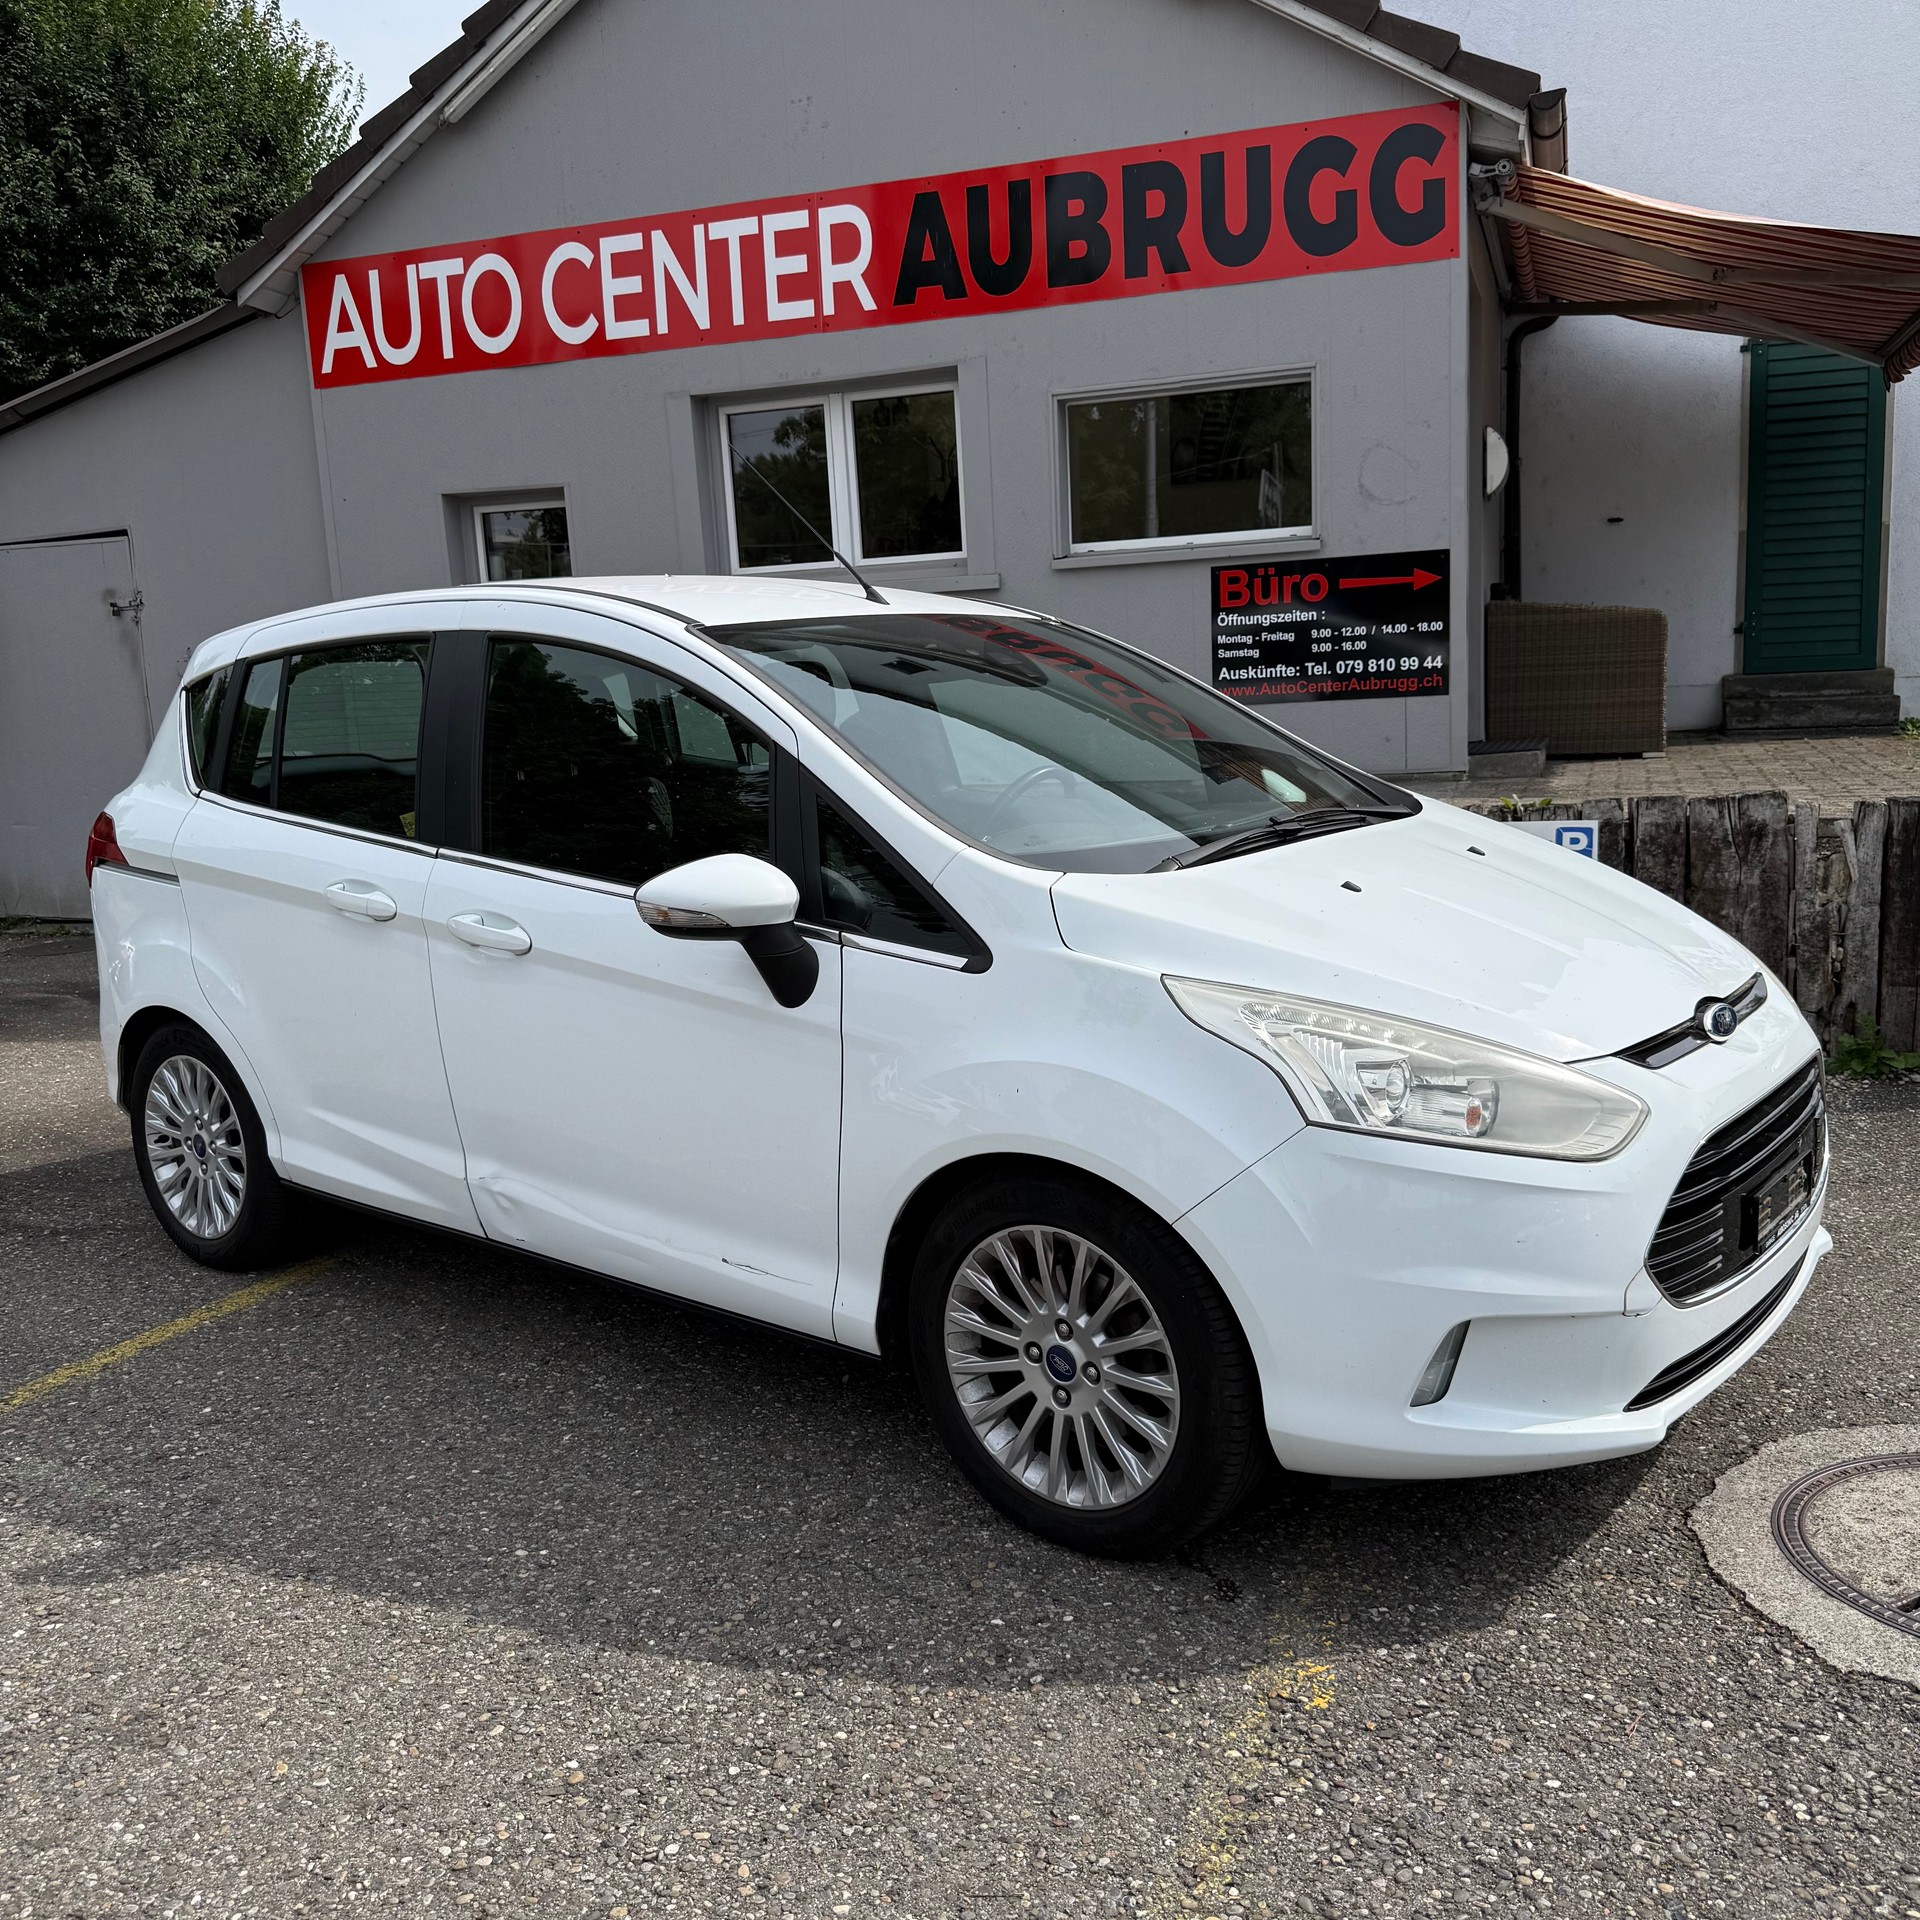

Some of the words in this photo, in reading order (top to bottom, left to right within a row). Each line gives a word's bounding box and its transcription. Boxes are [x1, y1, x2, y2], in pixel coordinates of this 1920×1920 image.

[321, 253, 522, 374] AUTO
[542, 204, 878, 345] CENTER
[893, 123, 1446, 306] AUBRUGG
[1219, 568, 1328, 608] Büro
[1217, 609, 1317, 627] Öffnungszeiten
[1217, 634, 1253, 645] Montag
[1261, 631, 1295, 642] Freitag
[1311, 628, 1332, 639] 9.00
[1340, 626, 1367, 637] 12.00
[1381, 623, 1407, 634] 14.00
[1416, 621, 1443, 632] 18.00
[1218, 648, 1260, 658] Samstag
[1311, 643, 1332, 653] 9.00
[1341, 640, 1367, 651] 16.00
[1218, 664, 1300, 680] Auskünfte:
[1305, 661, 1331, 676] Tel.
[1336, 660, 1364, 674] 079
[1367, 658, 1396, 672] 810
[1400, 656, 1419, 671] 99
[1423, 655, 1443, 669] 44
[1219, 673, 1443, 697] www.AutoCenterAubrugg.ch
